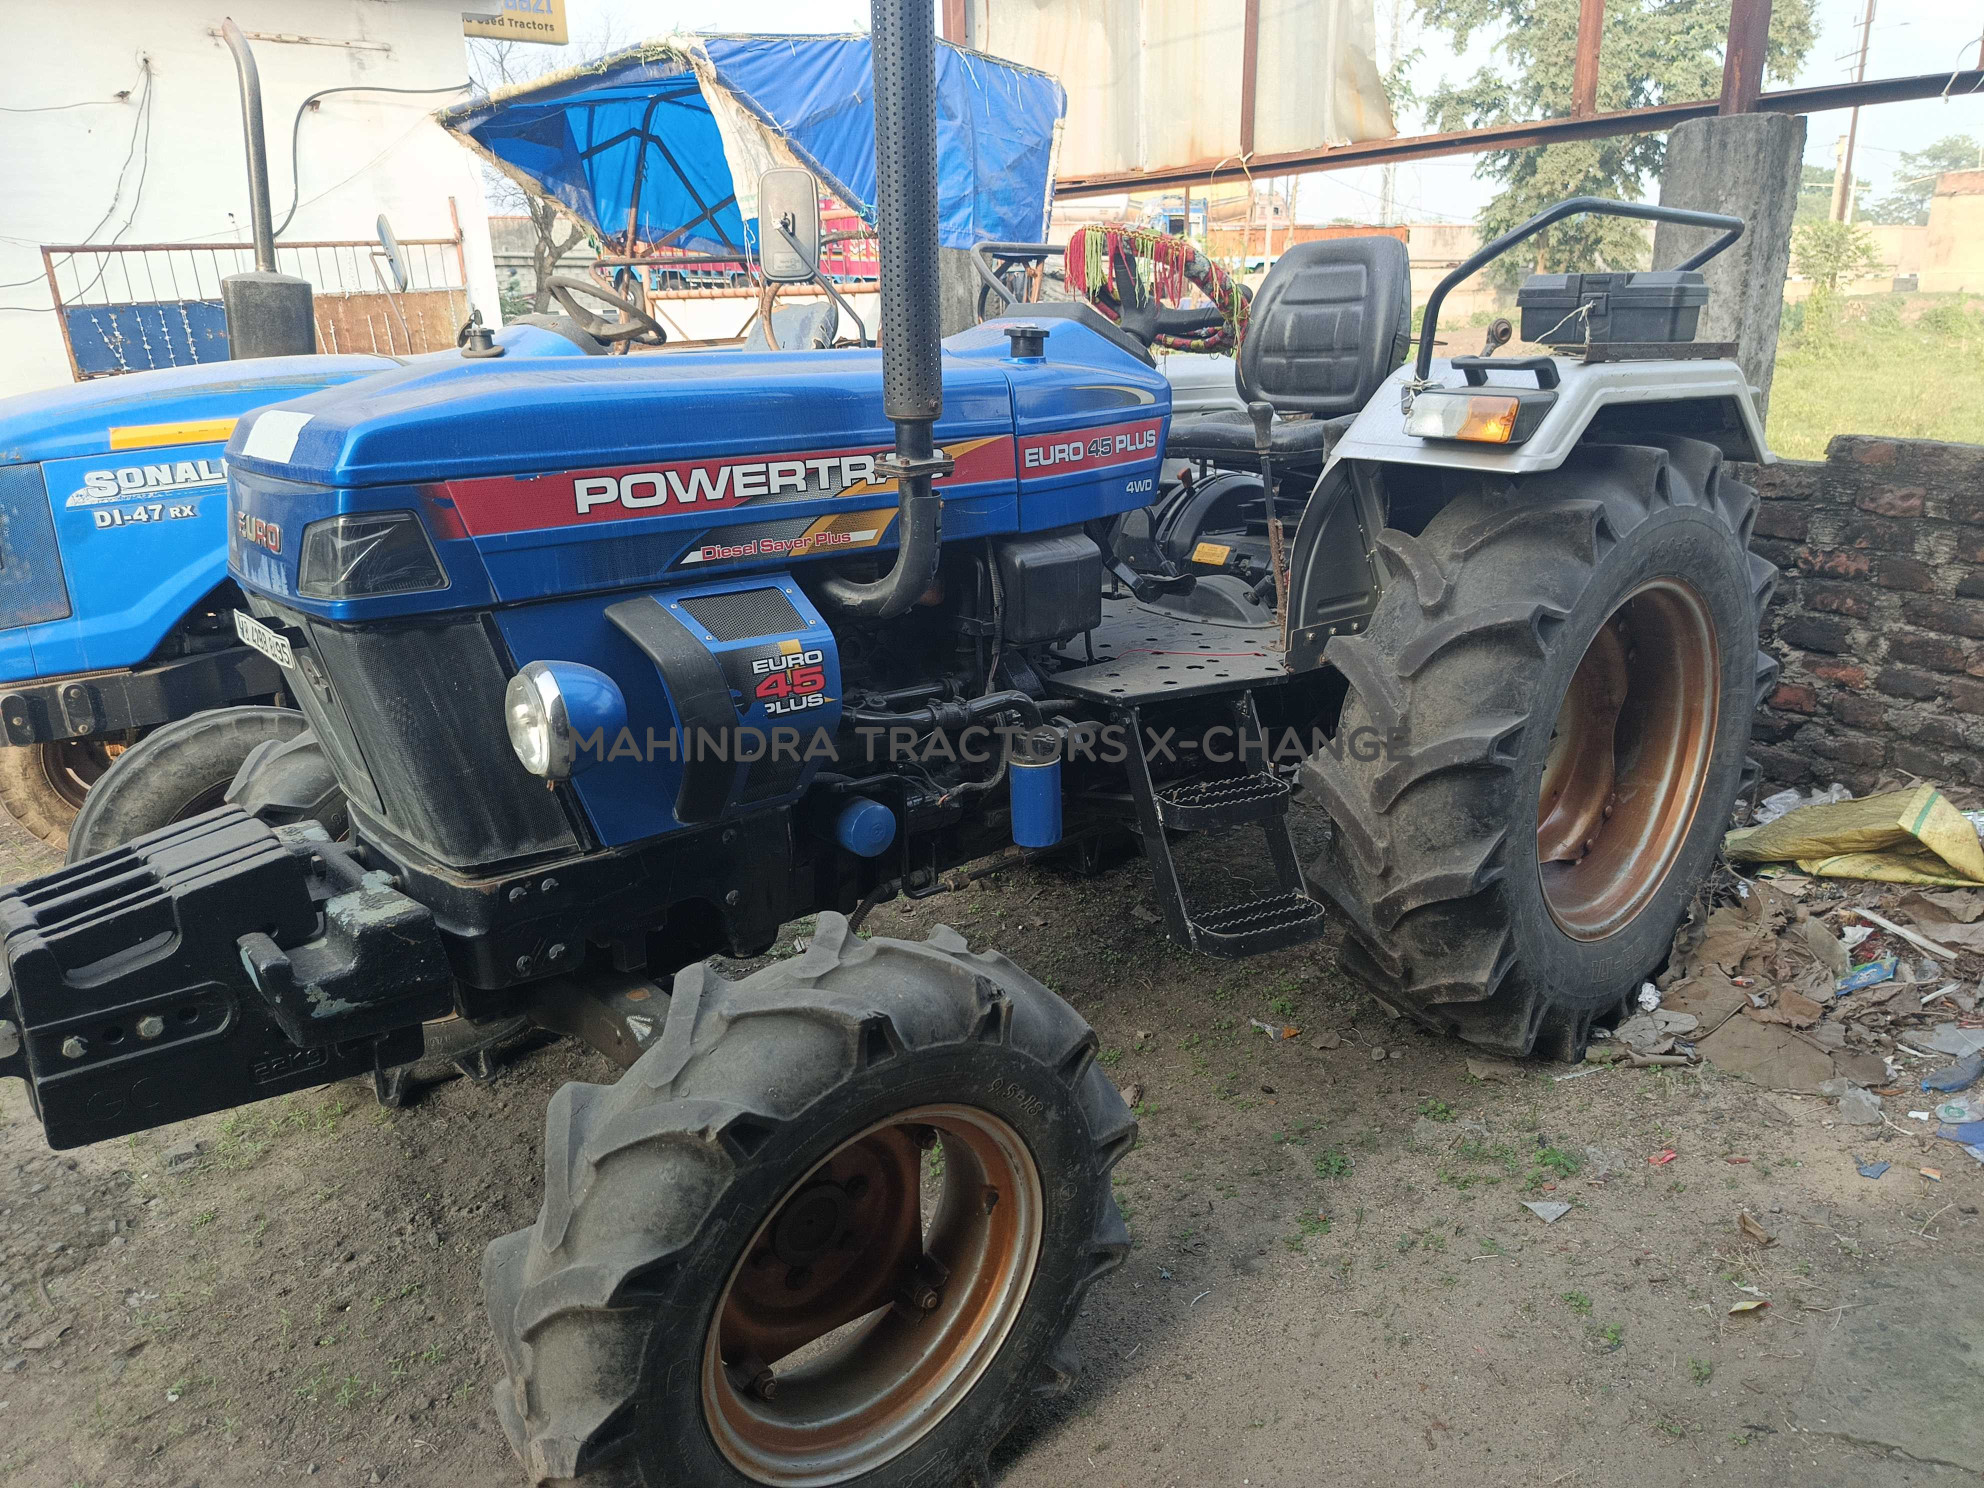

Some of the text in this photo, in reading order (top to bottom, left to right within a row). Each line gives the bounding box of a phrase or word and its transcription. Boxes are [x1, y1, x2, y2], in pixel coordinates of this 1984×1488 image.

[507, 18, 555, 32] Tractors
[1024, 429, 1156, 468] EURO 45 PLUS
[574, 448, 944, 514] POWERTR
[1125, 479, 1152, 494] 4WD
[93, 504, 196, 529] DI-47 RX
[237, 511, 283, 555] EURO
[701, 530, 851, 561] Diesel Saver Plus
[752, 649, 824, 675] EURO
[755, 665, 826, 699] 45
[987, 1077, 1044, 1117] 9.5-18
